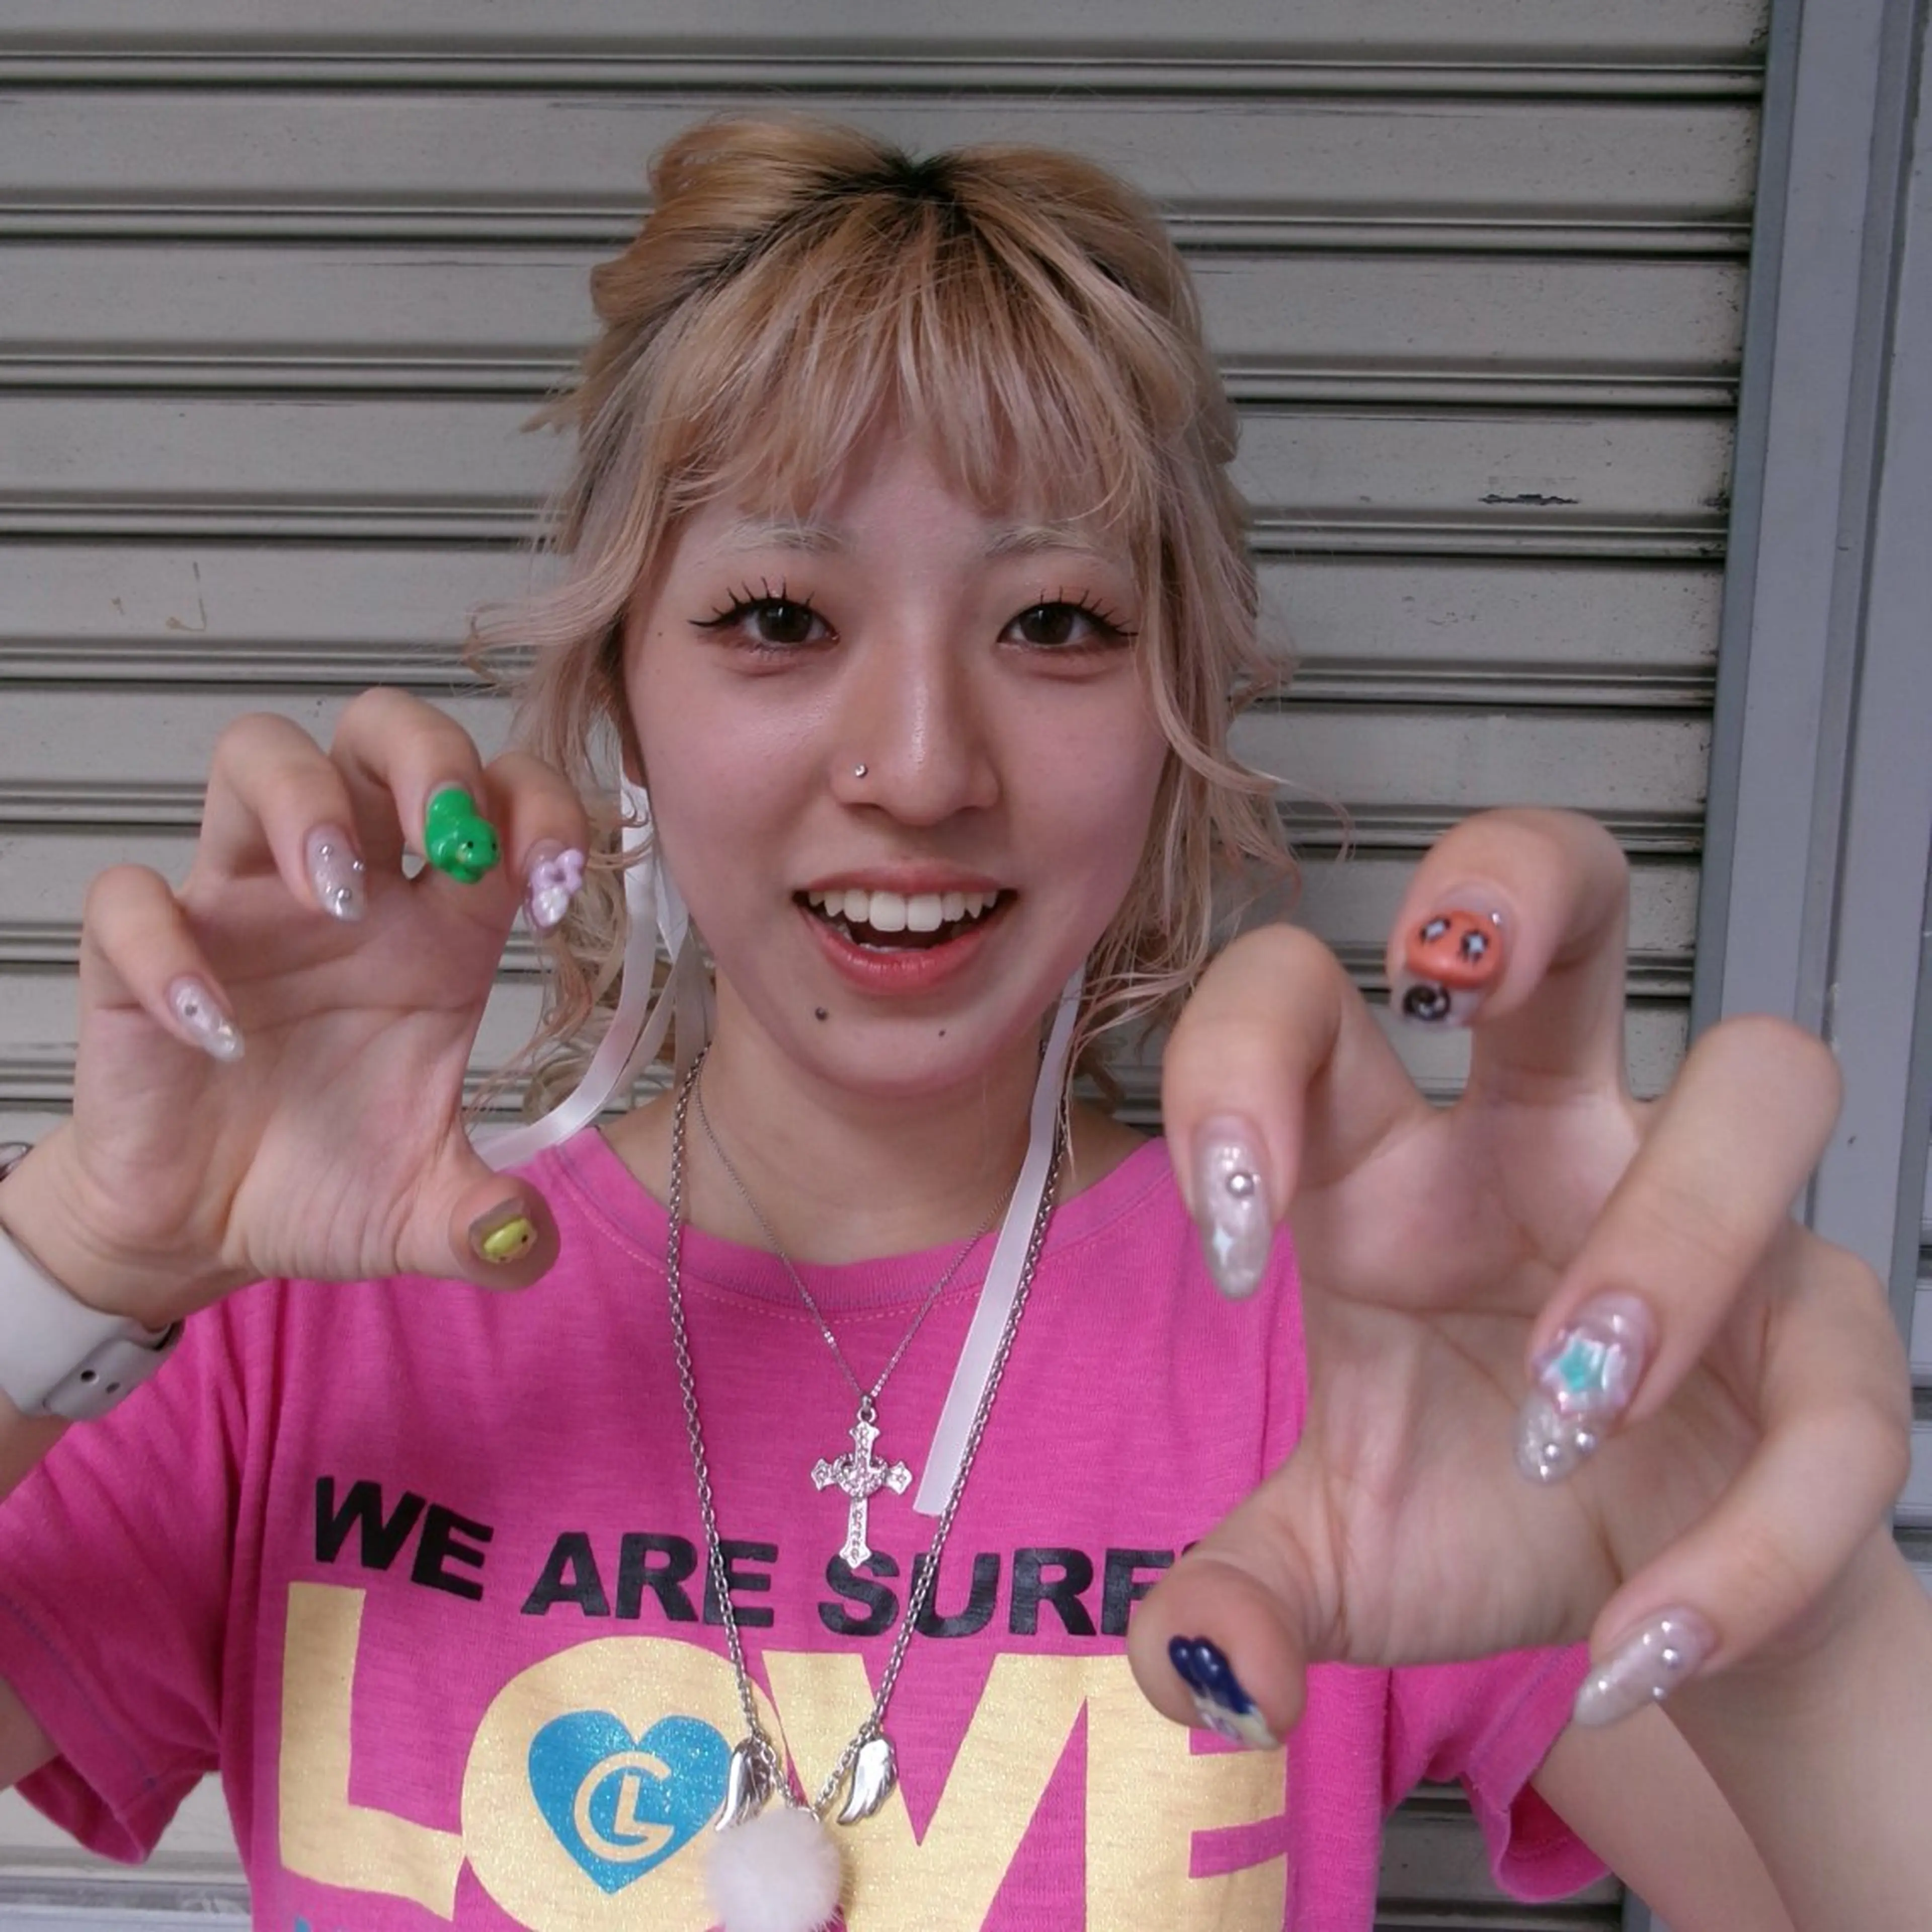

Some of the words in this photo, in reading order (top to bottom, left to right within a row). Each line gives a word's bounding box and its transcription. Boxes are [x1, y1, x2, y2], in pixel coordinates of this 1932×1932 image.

[315, 1476, 494, 1601] WE
[520, 1531, 779, 1628] ARE
[818, 1542, 1201, 1639] SURF
[278, 1580, 1288, 1932] LOVE
